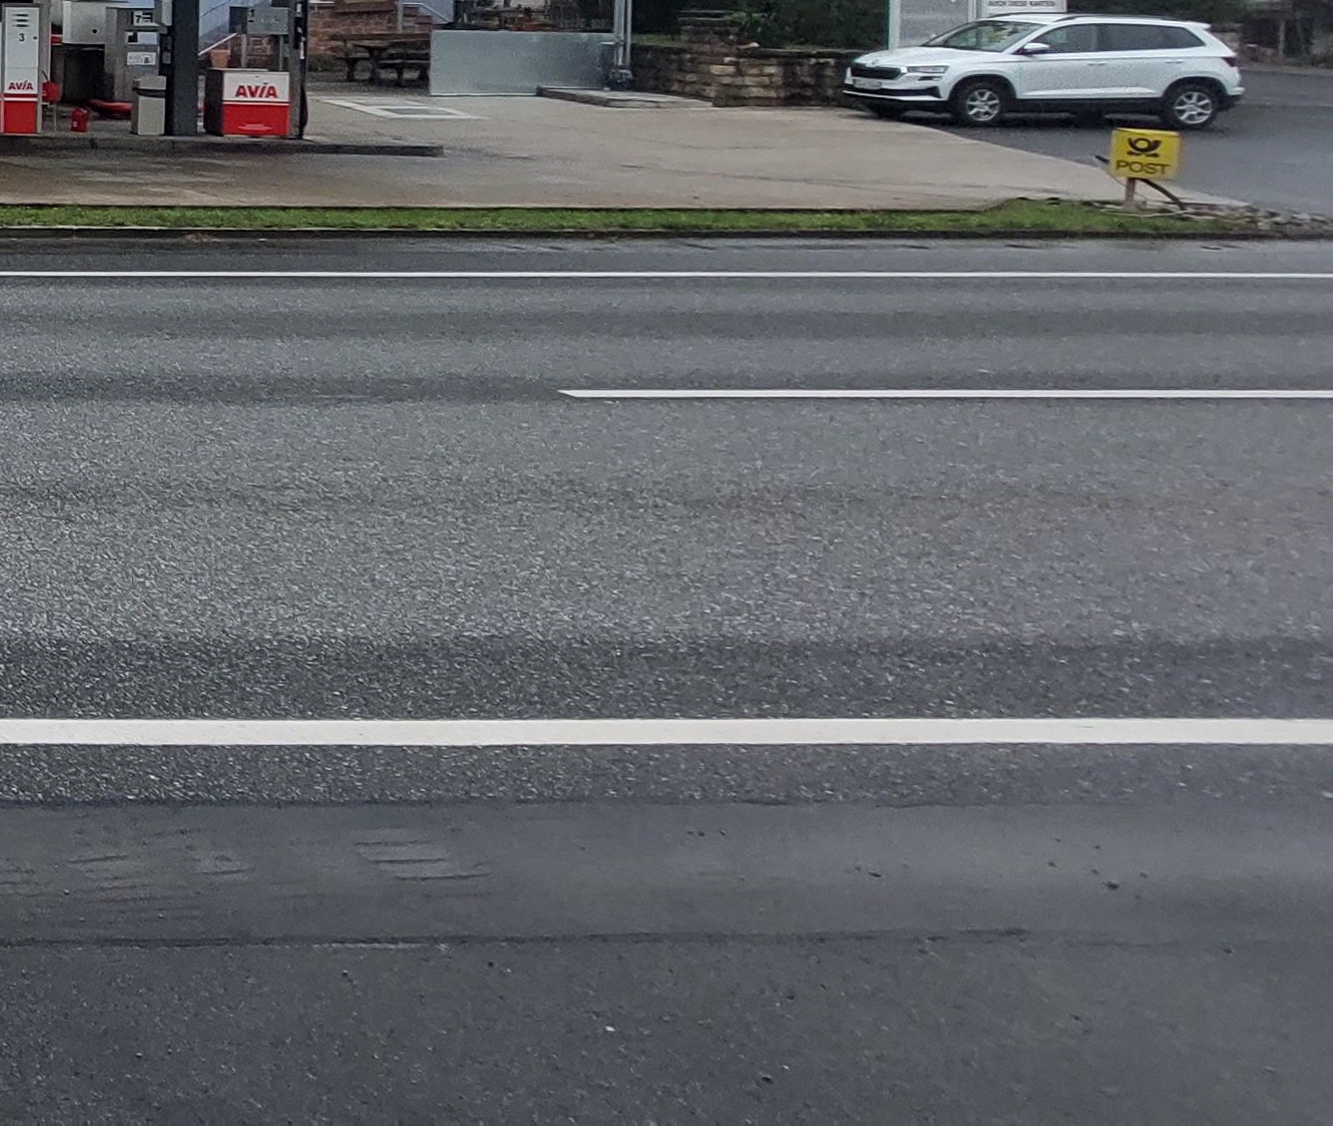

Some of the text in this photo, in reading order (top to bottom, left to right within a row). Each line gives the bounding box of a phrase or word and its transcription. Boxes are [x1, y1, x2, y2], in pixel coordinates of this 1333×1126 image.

[18, 33, 25, 42] 3
[8, 80, 34, 91] AVIA
[235, 82, 279, 98] AVIA
[1116, 160, 1171, 175] POST
